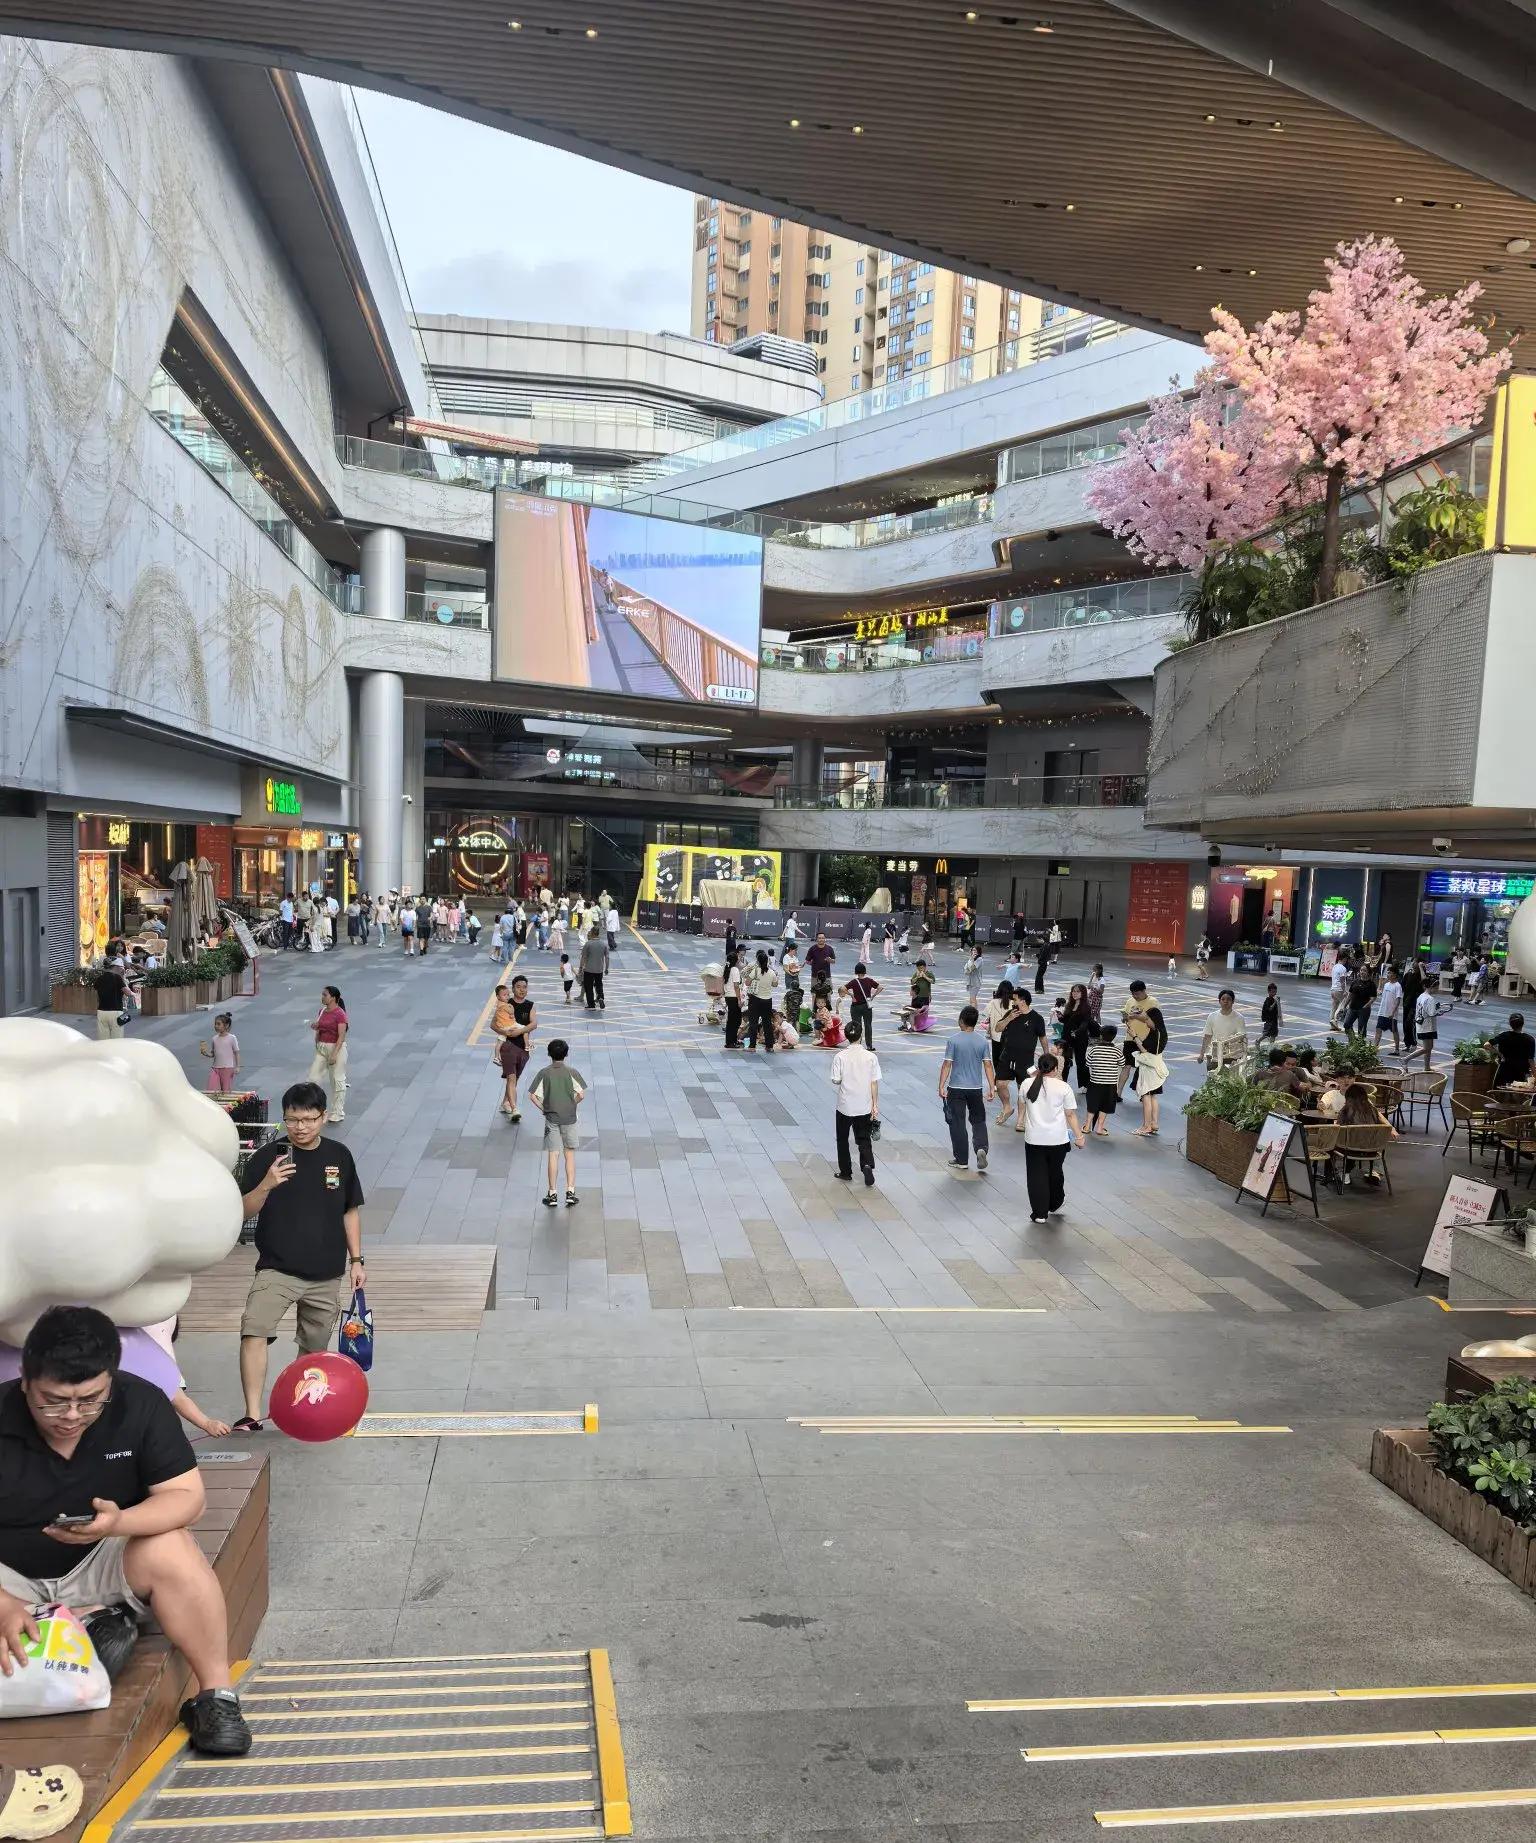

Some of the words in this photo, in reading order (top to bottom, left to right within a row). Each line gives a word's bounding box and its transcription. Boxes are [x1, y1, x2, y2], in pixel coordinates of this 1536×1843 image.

[617, 605, 650, 618] ERKE
[458, 836, 502, 849] 文体中心
[886, 860, 919, 872] 麦当劳
[1447, 877, 1506, 894] 茶救星球
